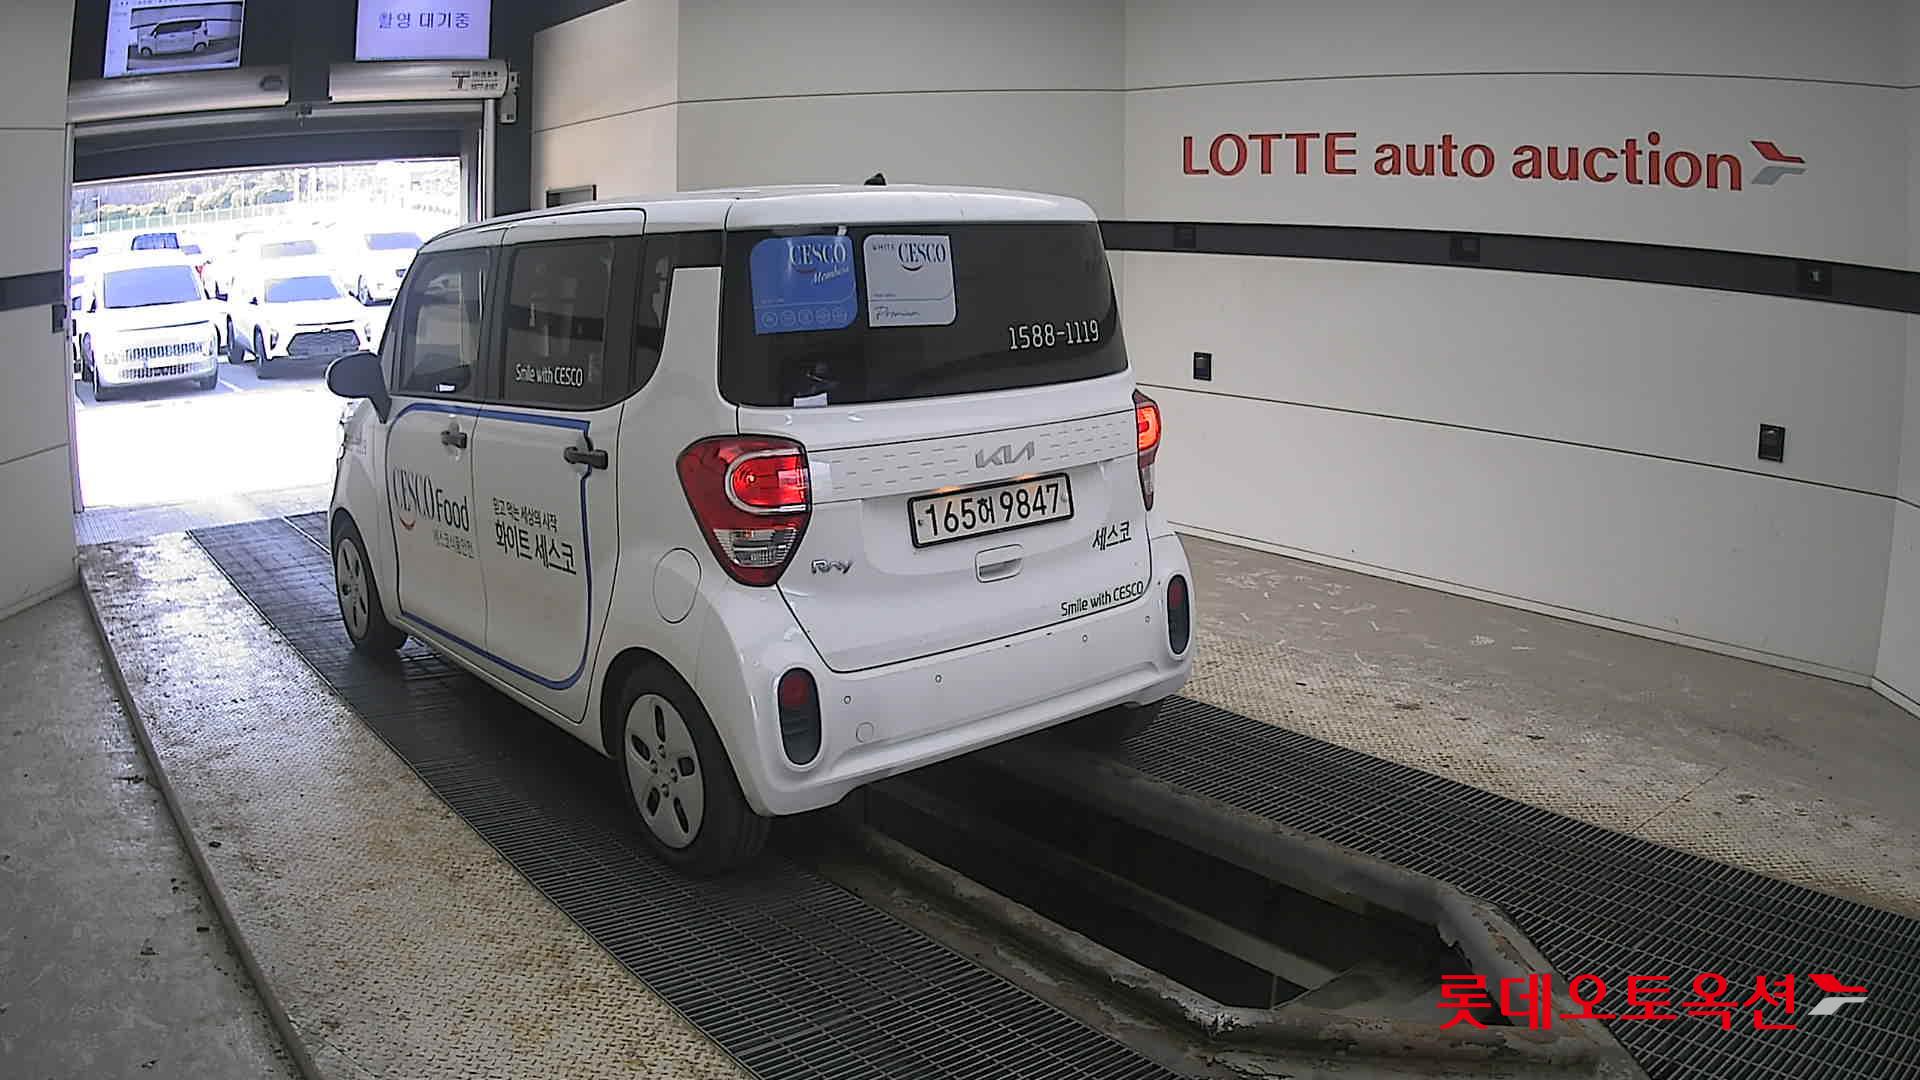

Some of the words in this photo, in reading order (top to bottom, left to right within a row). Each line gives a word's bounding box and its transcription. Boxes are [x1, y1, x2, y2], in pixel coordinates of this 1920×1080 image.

[419, 12, 470, 29] 대기중
[1182, 131, 1358, 177] LOTTE
[1374, 133, 1496, 178] auto
[1512, 130, 1743, 191] auction
[789, 242, 847, 266] CESCO
[898, 242, 946, 263] CESCO
[1008, 319, 1100, 350] 1588-1119
[535, 366, 554, 384] with
[554, 367, 584, 387] CESCO
[392, 468, 435, 521] CESCO
[435, 487, 470, 532] Food
[999, 482, 1060, 523] 9847
[542, 511, 559, 534] 시작
[1092, 520, 1133, 551] 세스코
[495, 519, 534, 561] 화이트
[534, 533, 577, 576] 세스코
[1060, 597, 1089, 617] Smile
[1089, 590, 1113, 609] with
[1112, 580, 1144, 602] CESCO
